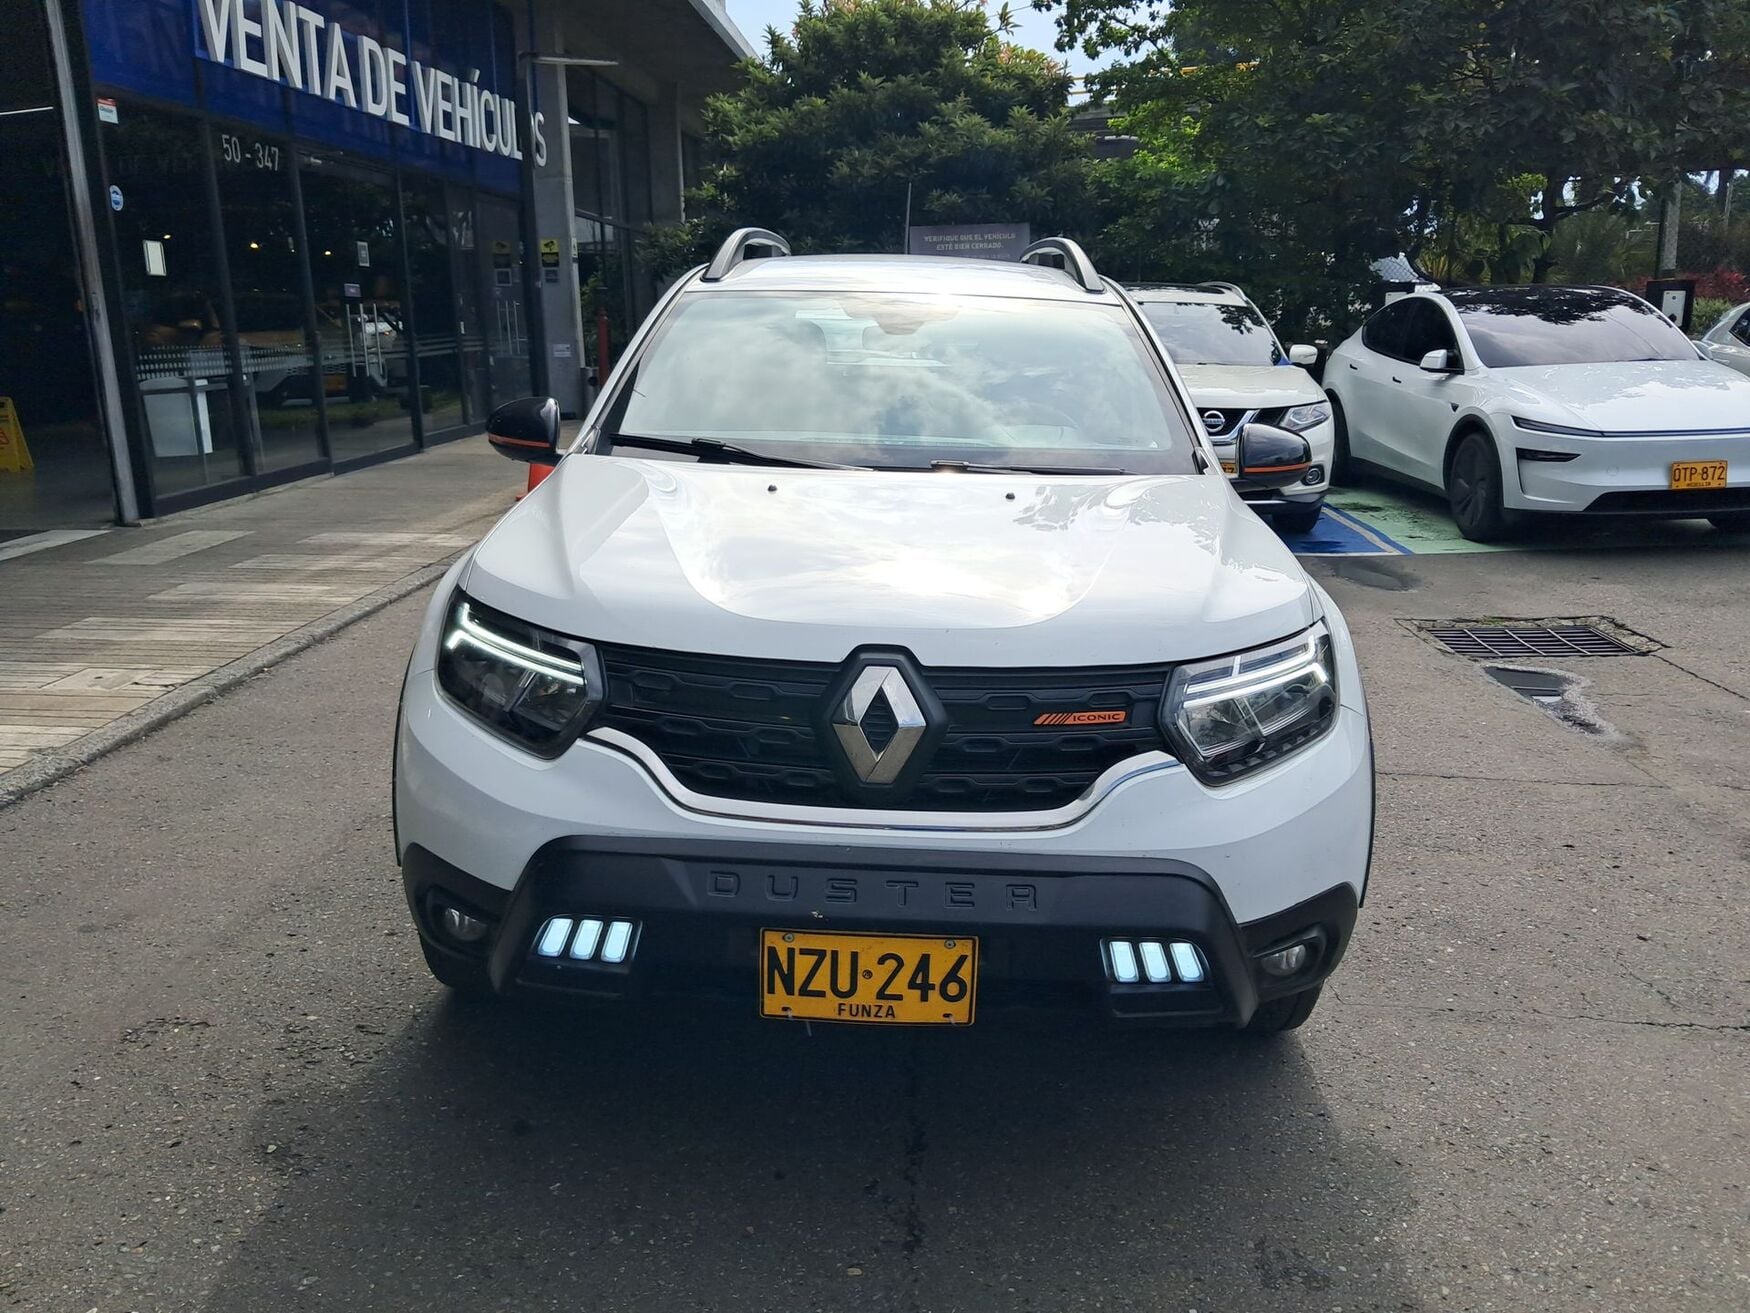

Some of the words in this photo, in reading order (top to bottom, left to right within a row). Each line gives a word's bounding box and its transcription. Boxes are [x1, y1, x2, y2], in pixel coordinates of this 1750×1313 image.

[198, 0, 357, 108] VENTA
[357, 35, 410, 126] DE
[221, 133, 241, 163] 50
[255, 142, 279, 171] 347
[1073, 713, 1121, 722] ICONIC
[706, 870, 1038, 912] DUSTER
[837, 1002, 896, 1019] FUNZA
